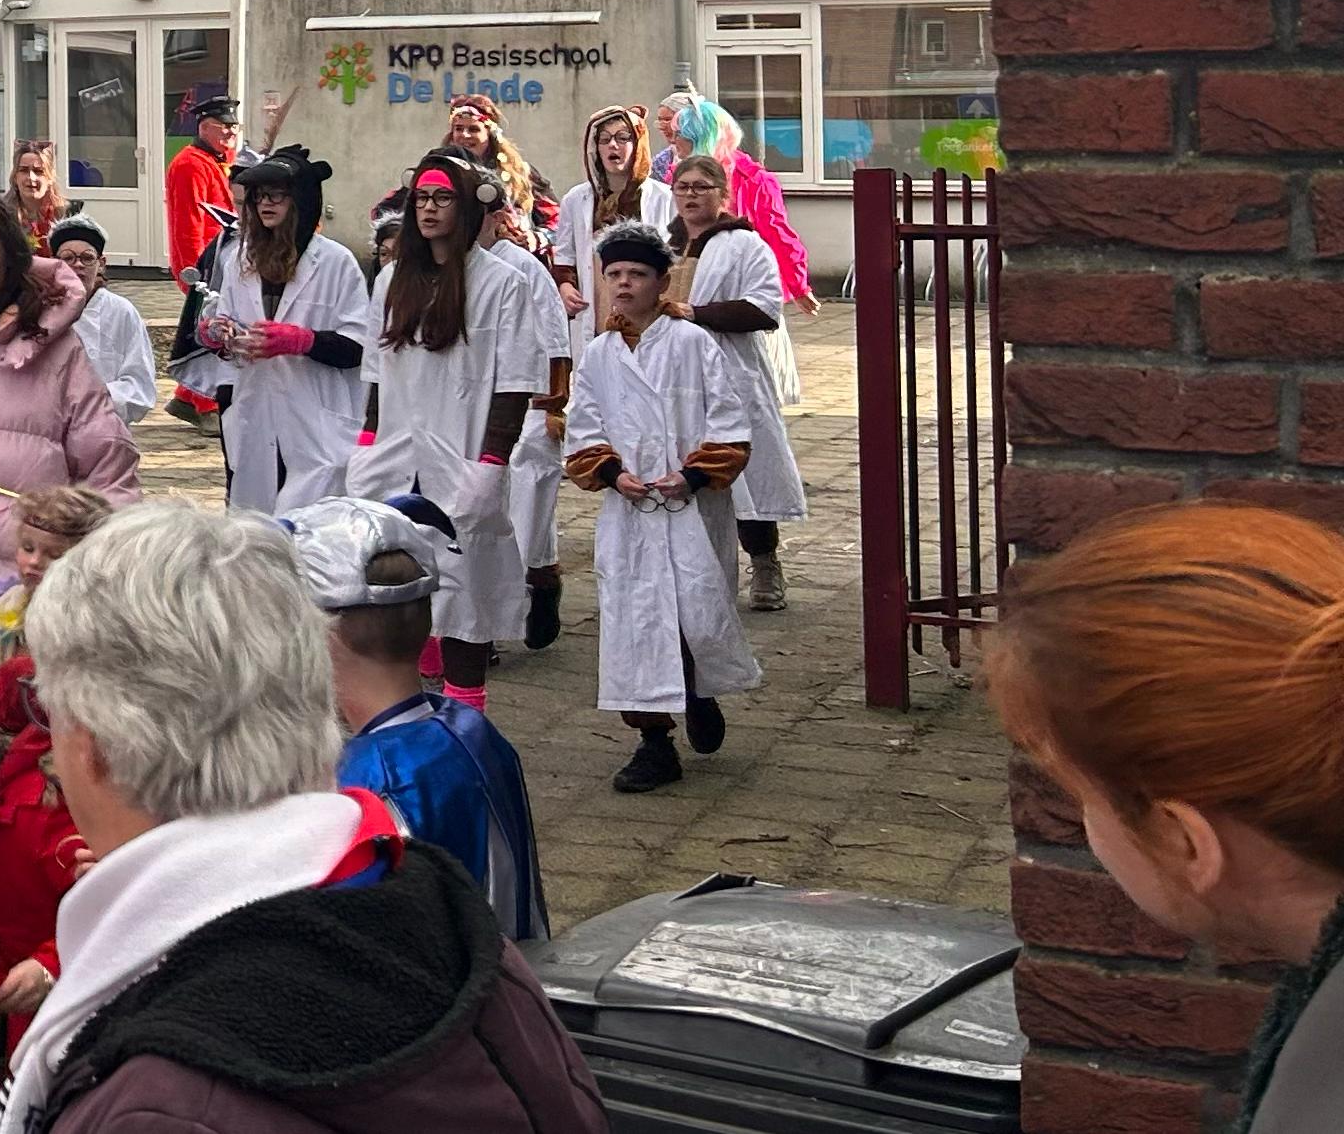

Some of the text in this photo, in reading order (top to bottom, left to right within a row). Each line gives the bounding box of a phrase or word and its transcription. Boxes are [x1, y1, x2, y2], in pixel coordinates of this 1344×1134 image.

[389, 43, 611, 69] KPO Basisschool
[388, 71, 544, 104] De Linde
